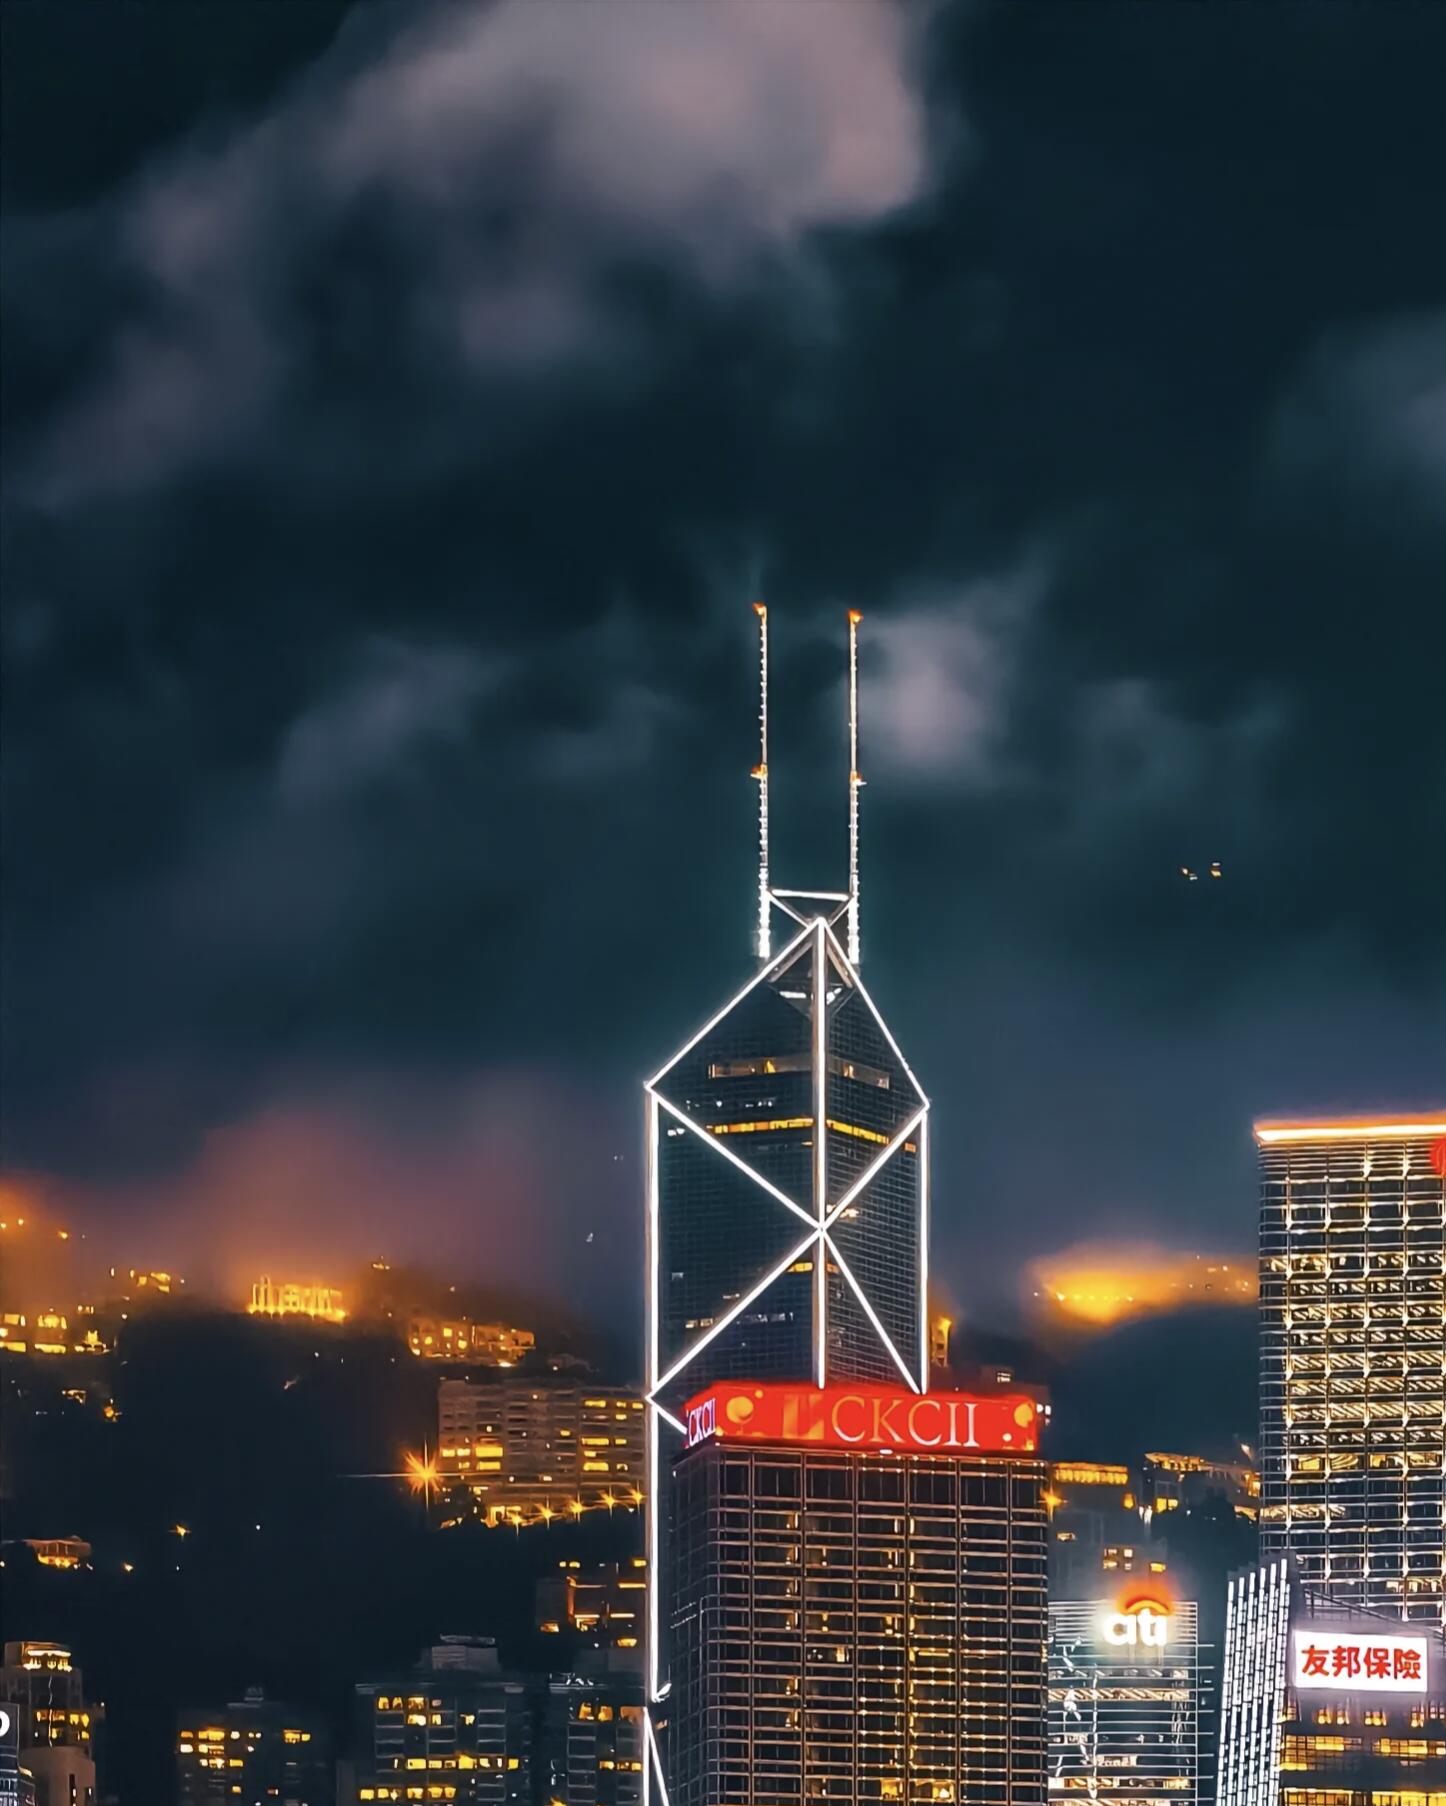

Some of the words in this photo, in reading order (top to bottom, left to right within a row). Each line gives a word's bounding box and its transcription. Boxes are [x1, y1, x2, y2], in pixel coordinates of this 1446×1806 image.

[831, 1395, 980, 1447] CKCII
[1103, 1607, 1168, 1647] citi
[1301, 1644, 1421, 1680] 友邦保險
